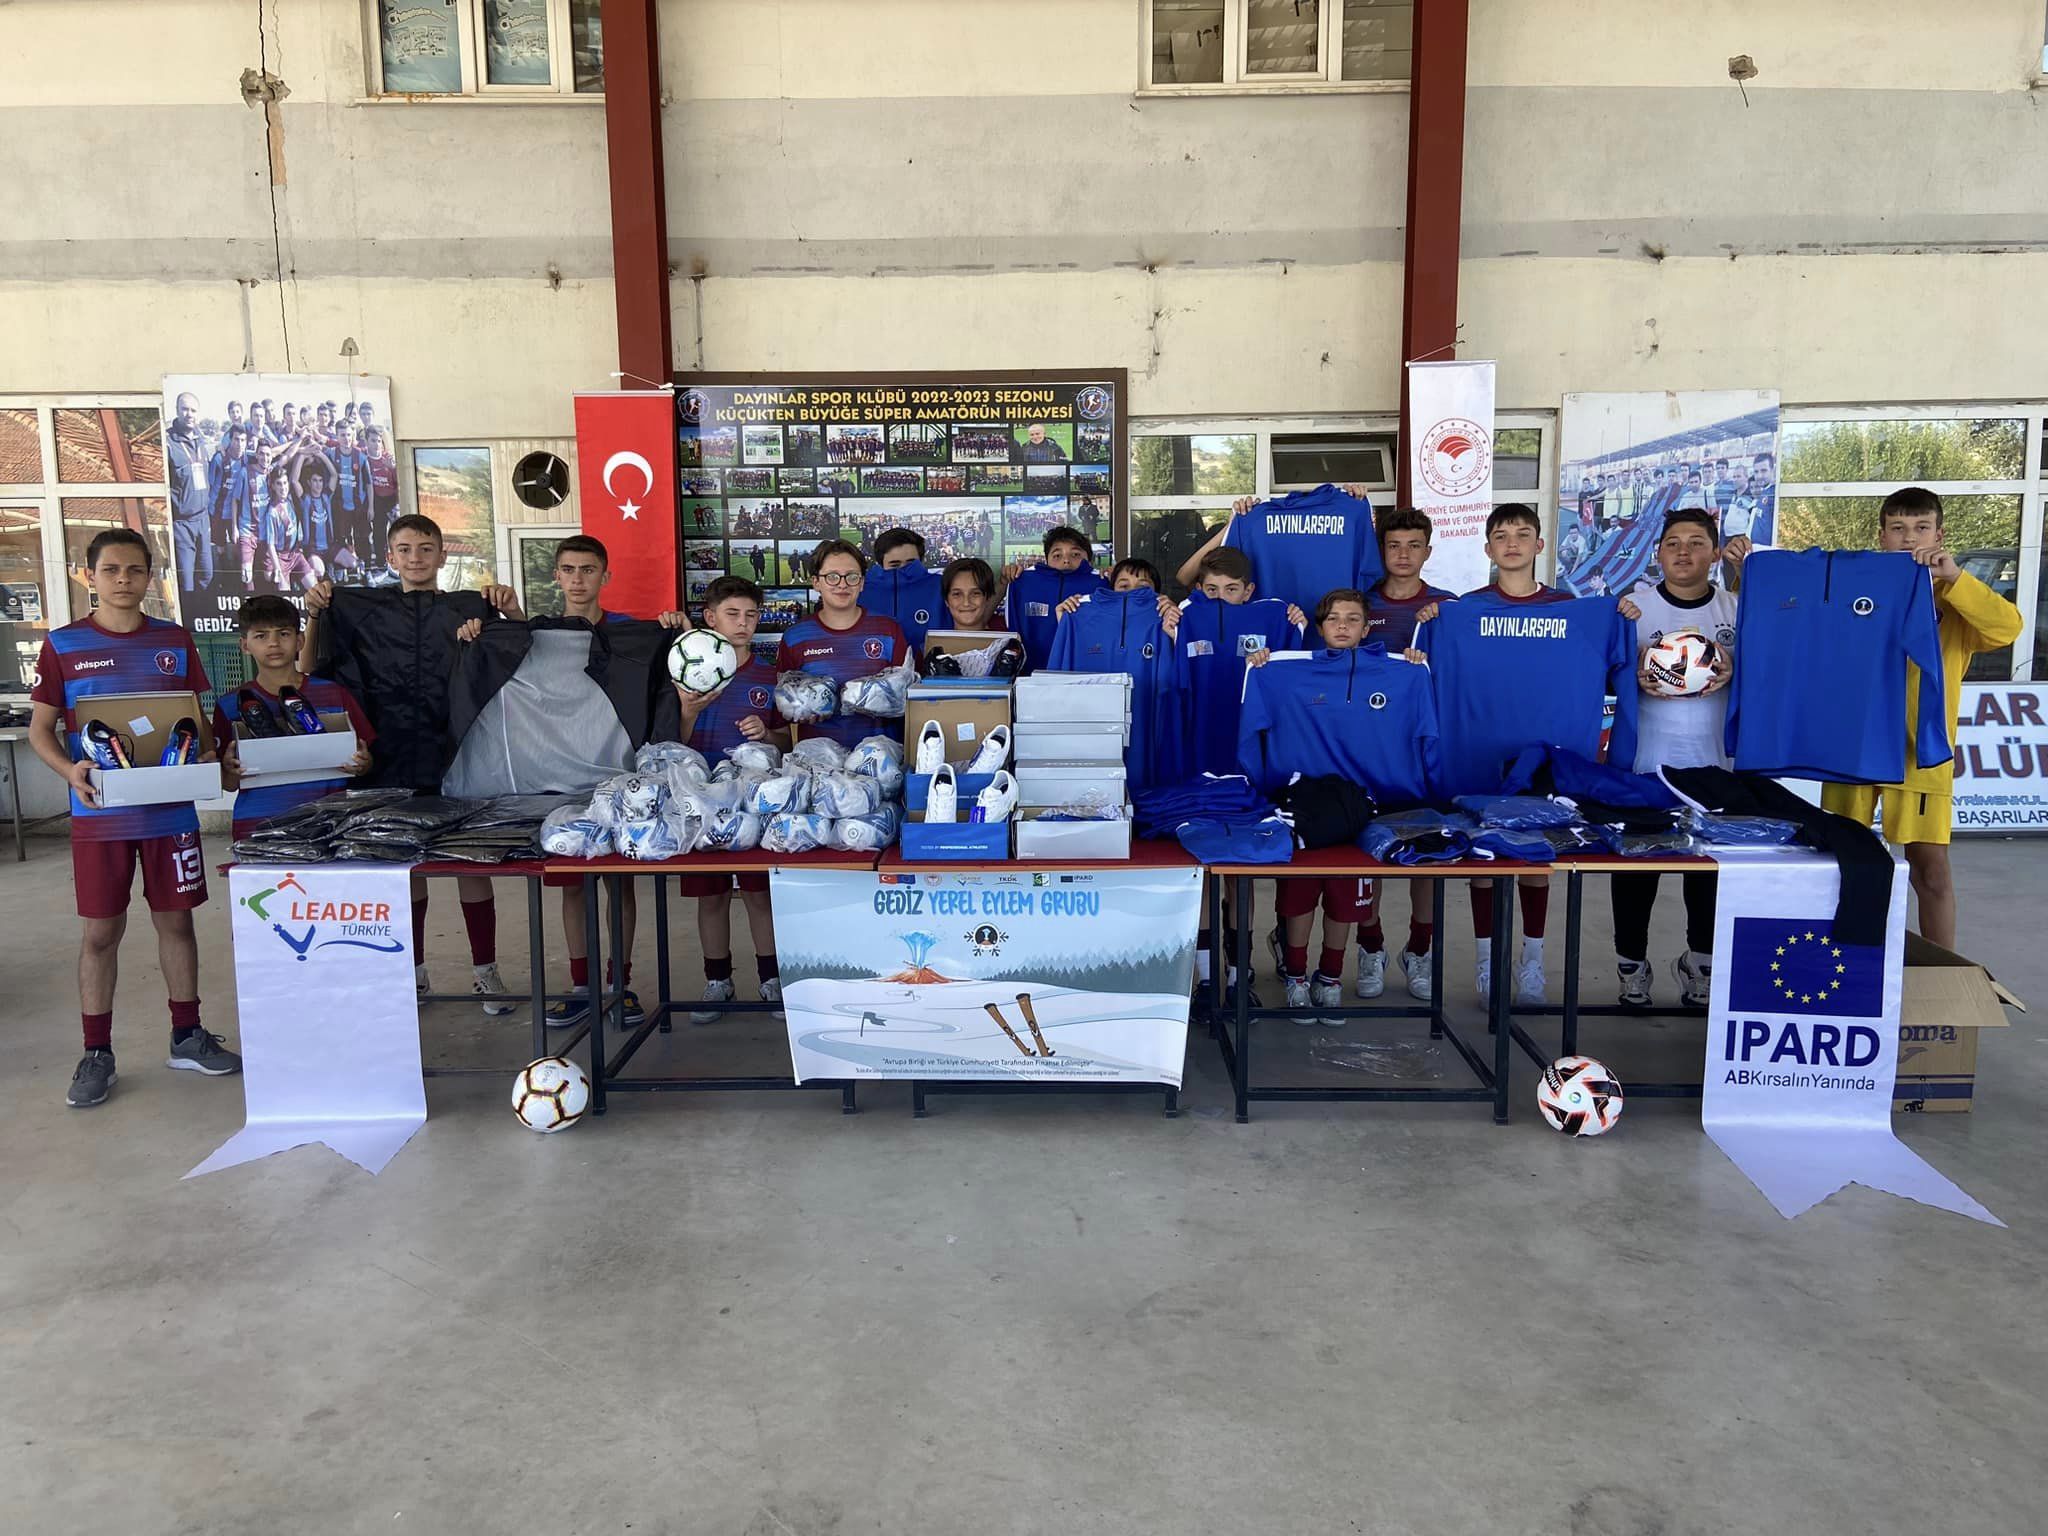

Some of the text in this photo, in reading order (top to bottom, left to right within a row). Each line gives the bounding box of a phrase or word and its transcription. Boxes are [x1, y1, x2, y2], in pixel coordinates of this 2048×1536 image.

[734, 388, 1055, 405] DAYINLAR SPOR KLÜBÜ 2022-2023 SEZONU
[715, 403, 1073, 423] KÜÇÜKTEN BÜYÜĞE SÜPER AMATÖRÜN HİKAYESİ
[1266, 515, 1345, 535] DAYINLARSPOR
[1433, 518, 1451, 527] ARIM
[1452, 517, 1461, 526] VE
[1440, 527, 1479, 538] BAKANLIĞI
[217, 595, 241, 611] U19
[1480, 616, 1567, 639] DAYINLARSPOR
[74, 658, 115, 671] uhlsport
[172, 846, 202, 882] 13
[873, 885, 1100, 917] GEDİZ YEREL EYLEM GRUBU
[291, 901, 391, 922] LEADER
[341, 923, 392, 936] TÜRKİYE
[1724, 1019, 1881, 1067] IPARD
[1899, 1025, 1958, 1042] oma
[1724, 1069, 1875, 1091] ABKırsalınYanında
